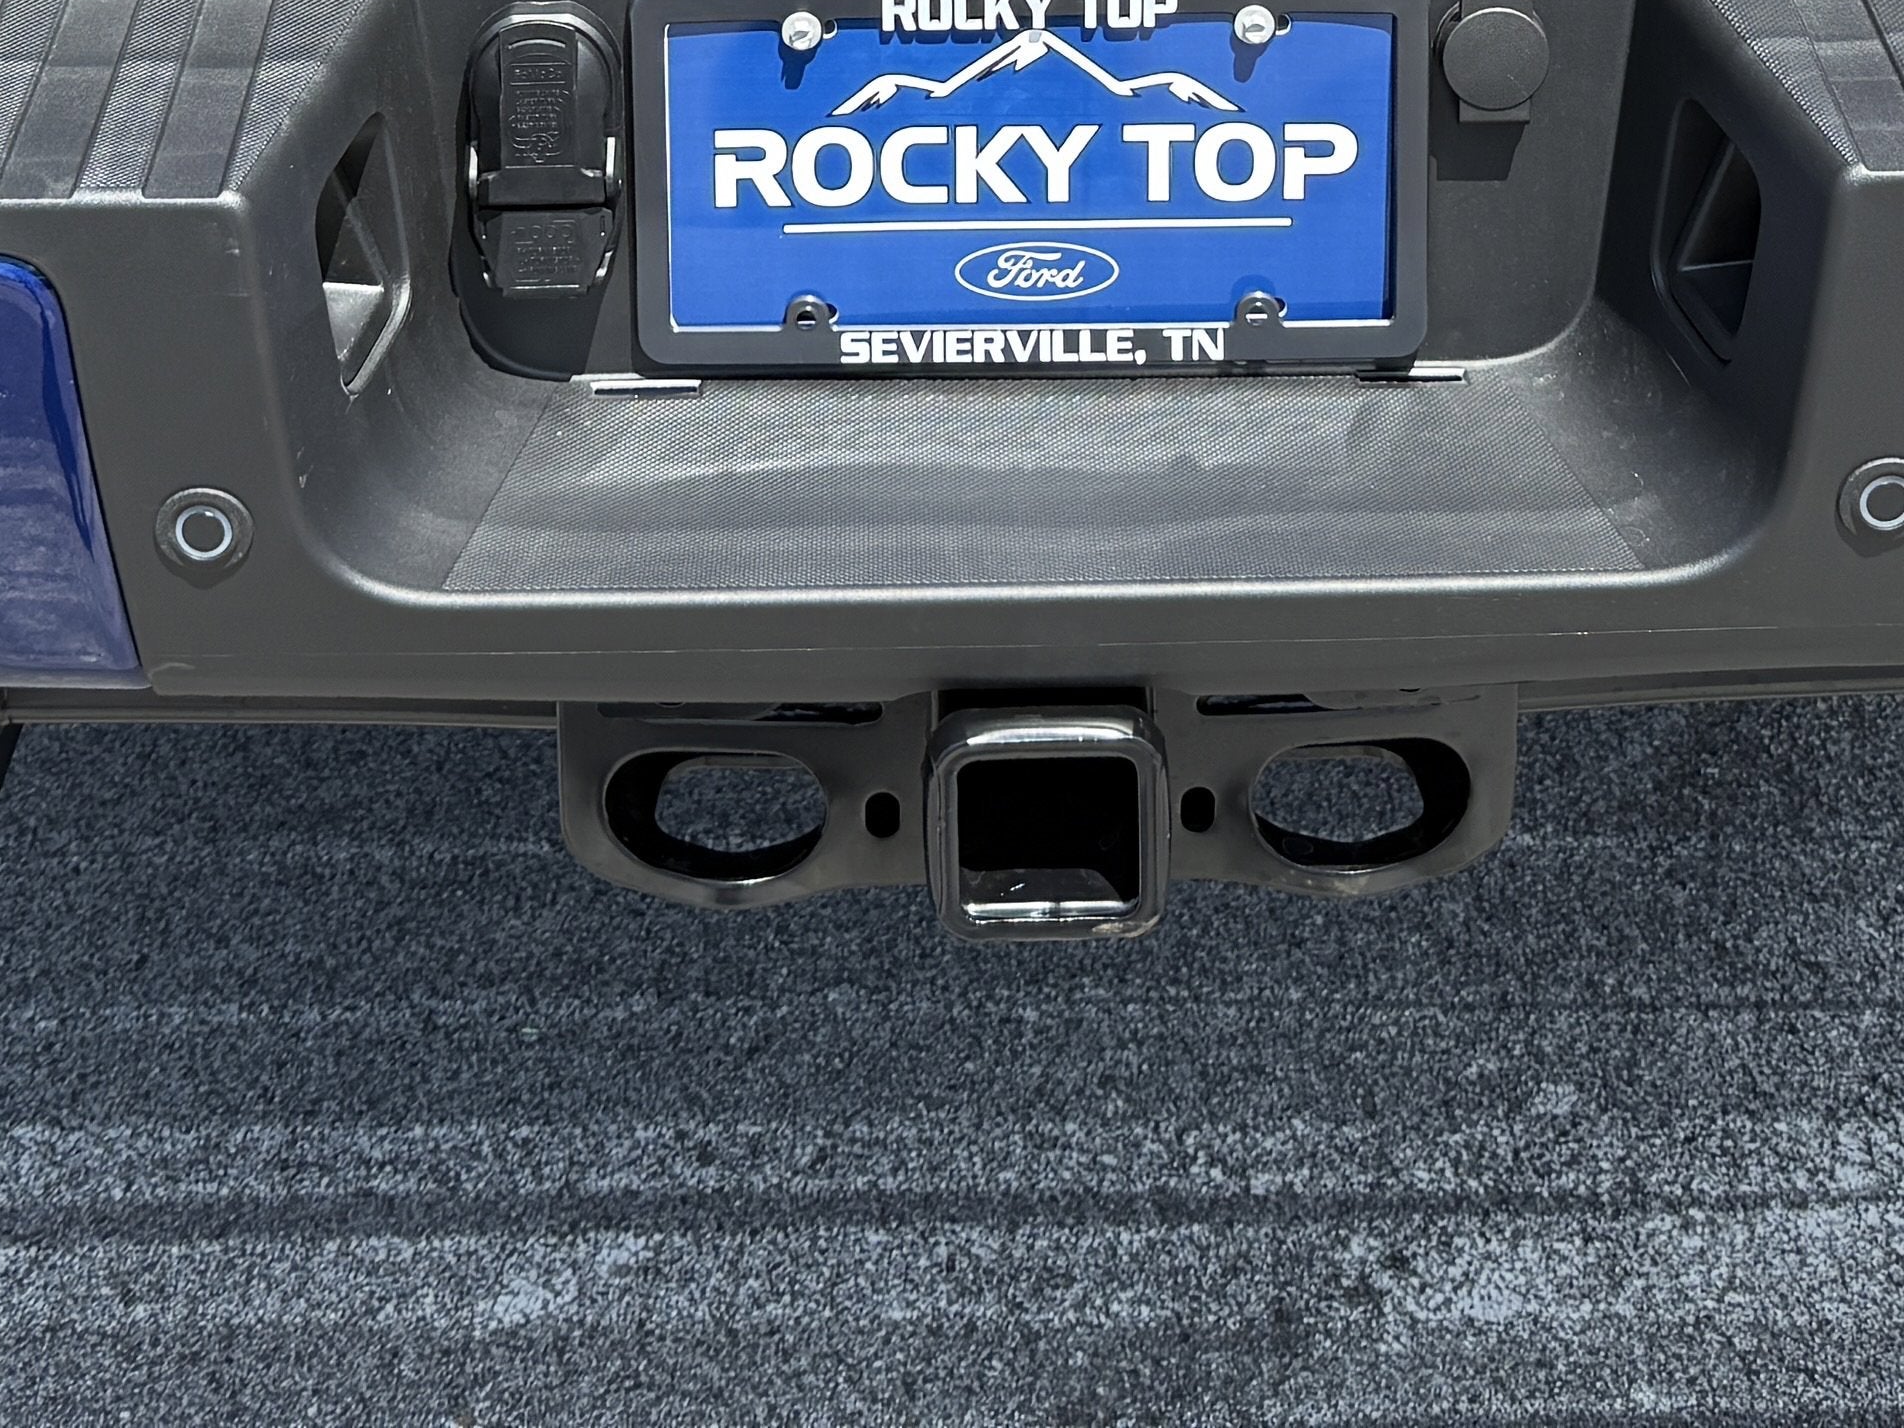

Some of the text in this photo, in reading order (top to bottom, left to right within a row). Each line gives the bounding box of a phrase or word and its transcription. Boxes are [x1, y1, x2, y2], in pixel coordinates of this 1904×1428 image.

[713, 121, 1360, 210] ROCKY TOP
[987, 243, 1086, 290] Ford
[838, 327, 1225, 366] SEVIERVILLE, TN
